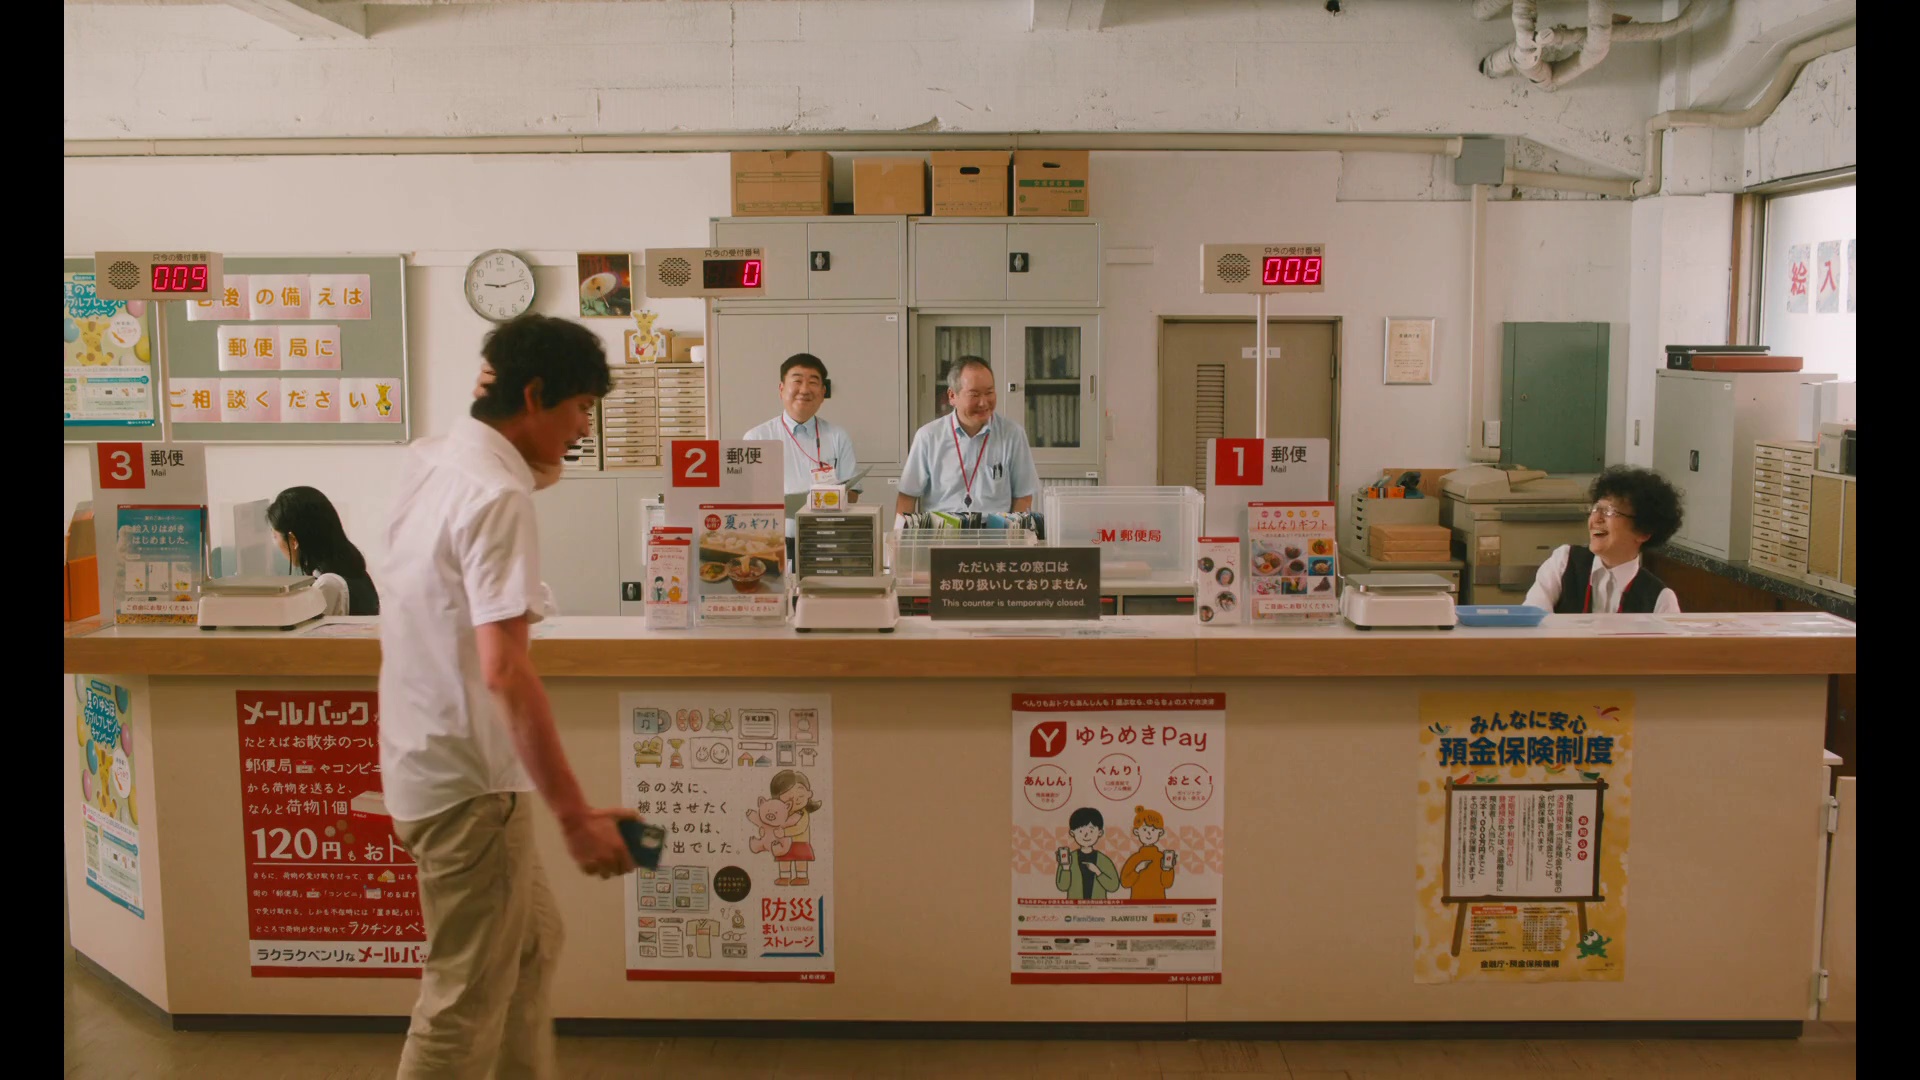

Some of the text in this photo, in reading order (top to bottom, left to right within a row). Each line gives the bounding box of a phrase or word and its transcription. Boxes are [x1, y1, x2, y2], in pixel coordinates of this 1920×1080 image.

[153, 253, 207, 261] 只今の受付番号
[704, 249, 760, 258] 只今の受付番号
[1264, 246, 1321, 255] 只今の受付番号
[743, 261, 760, 286] 0
[1264, 258, 1321, 283] 008
[153, 266, 207, 290] 009
[227, 337, 334, 358] 郵便局に
[169, 388, 367, 409] ご相談ください
[150, 449, 185, 467] 郵便
[726, 447, 763, 465] 郵便
[1271, 445, 1308, 463] 郵便
[110, 450, 133, 481] 3
[684, 447, 708, 478] 2
[1232, 447, 1245, 477] 1
[1270, 464, 1287, 474] Mail
[151, 468, 167, 477] Mail
[726, 466, 743, 475] Mail
[132, 524, 185, 533] 絵入りはがき
[724, 513, 779, 530] 夏のギフト
[1257, 519, 1328, 531] はんなりギフト
[132, 536, 189, 545] はじめました。
[1119, 529, 1161, 543] 郵便局
[957, 560, 1069, 573] ただいまこの窓口は
[939, 578, 1088, 591] お取り扱いしておりません
[126, 604, 193, 612] ご自由にお取りください
[706, 605, 776, 613] ご自由にお取りください
[942, 598, 1086, 608] This counter is temporarily closed.
[1264, 602, 1333, 610] ご自由にお取りください
[1470, 710, 1588, 735] みんなに安心
[1076, 725, 1208, 752] ゆらめきPay
[1438, 735, 1615, 766] 預金保険制度
[245, 758, 381, 775] 郵便局 やコンビニ
[1096, 765, 1142, 776] べんり!
[637, 780, 708, 794] 命の次に、
[1024, 776, 1073, 787] あんしん!
[1167, 775, 1213, 786] おとく!
[247, 782, 352, 795] から荷物を送ると、
[248, 799, 348, 816] なんと荷物1個
[638, 800, 727, 814] 被災させたく
[251, 827, 416, 863] 120円もおト
[1577, 815, 1589, 861] お知らせ
[761, 897, 815, 922] 防災
[762, 923, 785, 935] まい
[763, 935, 815, 948] ストレージ
